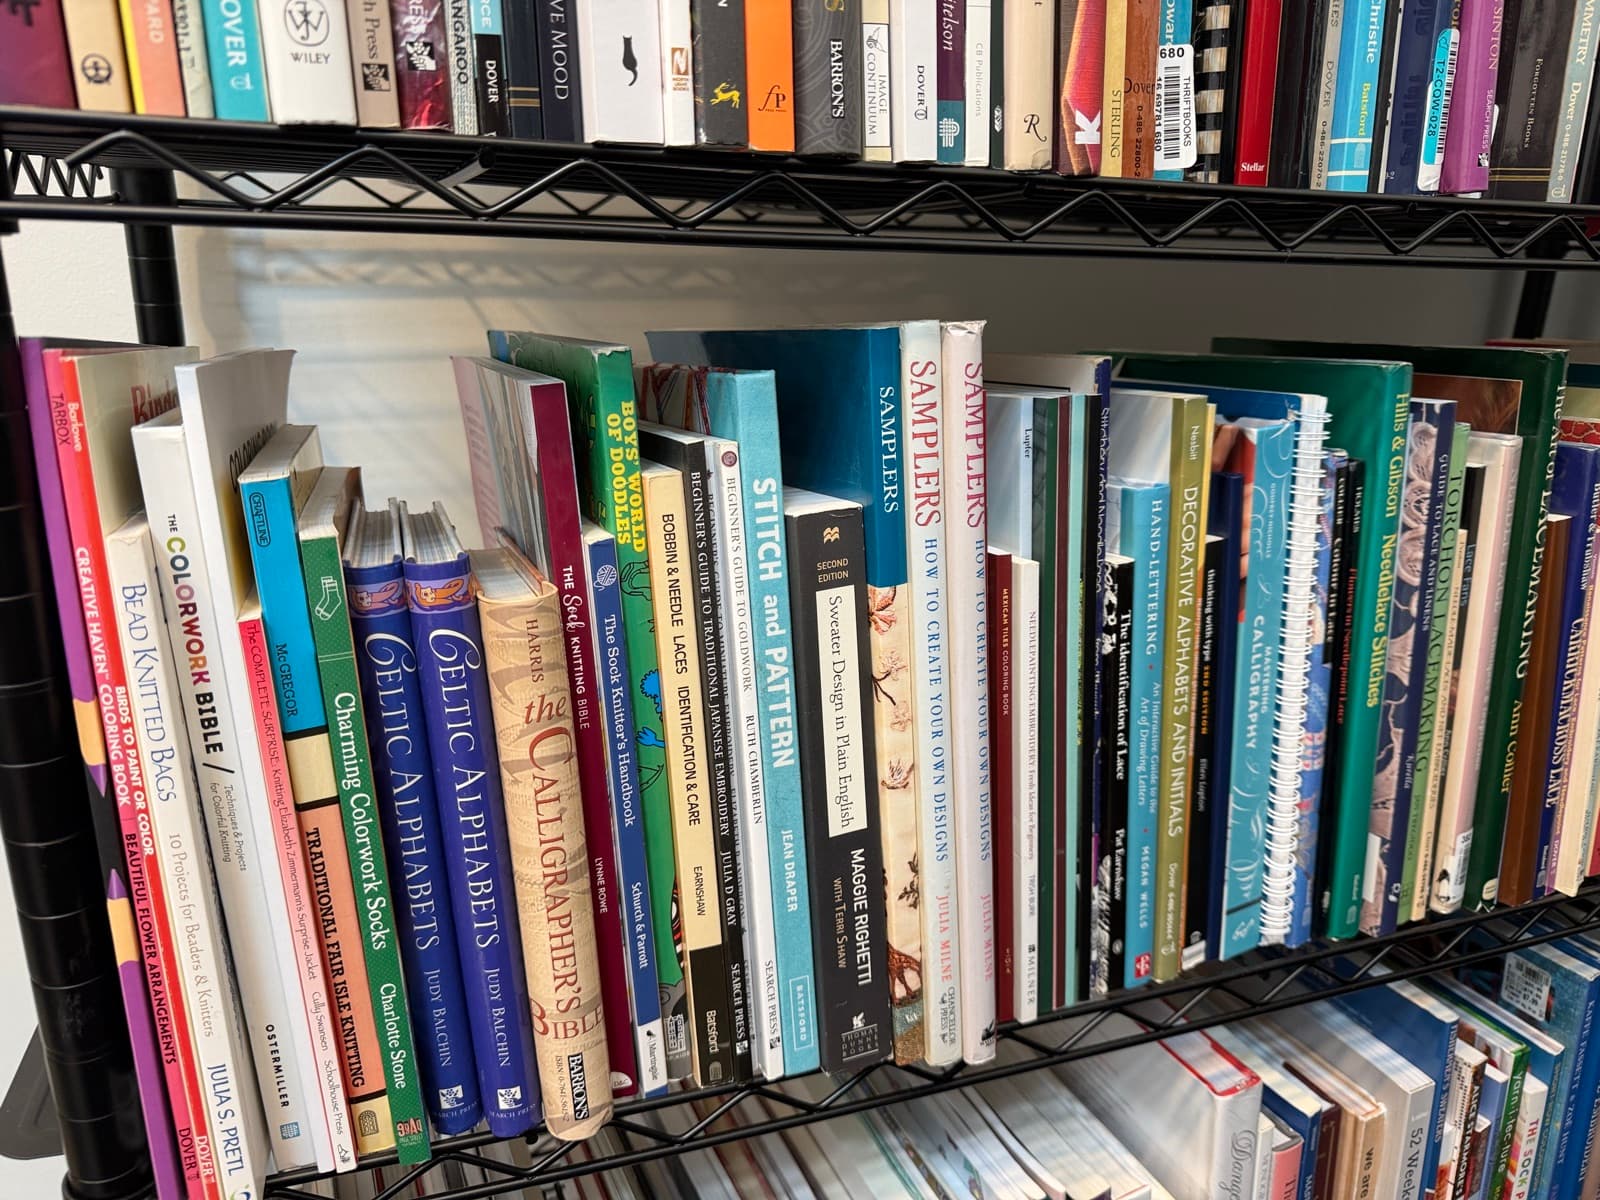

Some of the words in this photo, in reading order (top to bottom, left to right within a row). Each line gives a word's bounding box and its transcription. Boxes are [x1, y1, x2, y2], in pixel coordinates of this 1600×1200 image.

[291, 52, 330, 64] WILEY
[366, 18, 380, 59] Press
[1160, 48, 1184, 59] 680
[1488, 6, 1502, 70] SINTON
[484, 60, 498, 104] DOVER
[552, 29, 569, 100] MOOD
[831, 39, 844, 118] BARRON'S
[975, 59, 983, 118] Publications
[1323, 61, 1334, 107] DOVER
[1528, 58, 1543, 114] FORGOTTEN
[868, 52, 877, 134] CONTINUUM
[879, 74, 887, 114] IMAGE
[1183, 76, 1191, 146] THRIFTBOOKS
[1358, 82, 1370, 136] Batsford
[1484, 90, 1494, 120] SEARCH
[1110, 90, 1121, 158] STERLING
[1481, 122, 1490, 150] PRESS
[1523, 117, 1534, 148] BOOKS
[1240, 162, 1264, 172] Stellar
[52, 393, 70, 445] TARBOX
[68, 402, 82, 452] Barlowe
[608, 414, 622, 440] OF
[622, 401, 640, 465] BOYS'
[1395, 393, 1409, 432] Hills
[880, 387, 898, 513] SAMPLERS
[910, 361, 941, 526] SAMPLERS
[1191, 425, 1200, 460] Nesbitt
[1392, 437, 1404, 452] &
[610, 447, 631, 544] DOODLES
[627, 472, 646, 552] WORLD
[691, 472, 706, 549] BEGINNER'S
[1386, 456, 1402, 518] Gibson
[168, 514, 177, 532] THE
[251, 493, 269, 544] CRAFTLINE
[662, 514, 677, 564] BOBBIN
[727, 478, 741, 553] BEGINNER'S
[754, 477, 782, 581] STITCH
[1438, 471, 1464, 603] TORCHON
[698, 550, 710, 593] GUIDE
[817, 558, 848, 571] SECOND
[925, 539, 939, 579] HOW
[1179, 487, 1198, 608] DECORATIVE
[1464, 544, 1476, 574] Lace
[562, 567, 574, 589] THE
[733, 557, 744, 596] GUIDE
[818, 571, 849, 583] EDITION
[926, 588, 939, 612] TO
[1375, 535, 1395, 633] Needlelace
[1461, 576, 1472, 606] Fans
[166, 536, 211, 685] COLORWORK
[563, 595, 585, 631] Sock
[669, 578, 683, 626] NEEDLE
[702, 594, 711, 614] TO
[736, 599, 747, 615] TO
[764, 595, 786, 636] and
[829, 596, 842, 656] Sweater
[526, 619, 544, 683] HARRIS
[604, 614, 615, 643] The
[927, 620, 941, 687] CREATE
[76, 546, 100, 618] CREATIVE
[99, 684, 123, 763] COLORING
[112, 763, 130, 807] BOOK
[571, 637, 585, 694] KNITTING
[607, 647, 619, 684] Sock
[674, 635, 687, 674] LACES
[704, 619, 718, 700] TRADITIONAL
[736, 623, 752, 692] GOLDWORK
[1173, 615, 1190, 716] ALPHABETS
[1261, 647, 1271, 712] MASTERING
[1368, 639, 1386, 707] Stitches
[365, 632, 417, 757] CELTIC
[829, 659, 846, 712] Design
[1246, 615, 1264, 748] CALLIGRAPHY
[1415, 612, 1444, 772] LACEMAKING
[195, 692, 224, 754] BIBLE
[525, 694, 567, 725] the
[578, 699, 590, 729] BIBLE
[612, 687, 626, 749] Knitter's
[709, 703, 723, 758] JAPANESE
[746, 715, 756, 745] RUTH
[766, 646, 795, 768] PATTERN
[836, 715, 844, 730] in
[930, 693, 943, 739] YOUR
[1510, 700, 1523, 736] Ann
[678, 685, 696, 780] IDENTIFICATION
[837, 733, 850, 771] Plain
[1172, 724, 1186, 763] AND
[618, 753, 636, 827] Handbook
[748, 750, 762, 825] CHAMBERLIN
[931, 747, 945, 785] OWN
[1404, 755, 1414, 788] Kurella
[1501, 741, 1516, 793] Collier
[335, 692, 362, 790] Charming
[350, 793, 382, 894] Colorwork
[366, 896, 389, 951] Socks
[688, 793, 700, 826] CARE
[715, 760, 729, 836] EMBROIDERY
[835, 774, 854, 828] English
[1168, 768, 1186, 838] INITIALS
[782, 830, 793, 859] JEAN
[933, 792, 948, 862] DESIGNS
[306, 827, 333, 940] TRADITIONAL
[390, 770, 440, 950] ALPHABETS
[529, 726, 582, 1014] CALLIGRAPHER'S
[851, 848, 867, 912] MAGGIE
[1140, 846, 1149, 886] MEGAN
[694, 866, 705, 916] EARNSHAW
[786, 862, 797, 912] DRAPER
[1139, 893, 1148, 929] WELLS
[936, 895, 948, 934] JULIA
[126, 832, 149, 911] BEAUTIFUL
[139, 907, 156, 959] FLOWER
[149, 963, 176, 1064] ARRANGEMENTS
[327, 940, 345, 985] FAIR
[855, 915, 872, 985] RIGHETTI
[939, 940, 952, 983] MILNE
[333, 980, 351, 1014] ISLE
[424, 969, 443, 1002] JUDY
[732, 963, 741, 1003] SEARCH
[380, 983, 399, 1048] Charlotte
[390, 1050, 406, 1088] Stone
[433, 1007, 451, 1066] BALCHIN
[706, 1010, 719, 1053] Batsford
[736, 1006, 746, 1040] PRESS
[797, 985, 806, 1041] BATSFORD
[265, 1024, 289, 1108] OSTERMILLER
[340, 1015, 364, 1088] KNITTING
[569, 1054, 588, 1118] BARRON'S
[1469, 1085, 1480, 1118] ALICE
[179, 1127, 197, 1172] DOVER
[1411, 1128, 1423, 1148] 52
[1526, 1119, 1539, 1144] THE
[1366, 1147, 1375, 1170] we
[1455, 1118, 1476, 1197] STARMORE'S
[1518, 1150, 1532, 1188] SOCK
[1361, 1172, 1370, 1200] are
